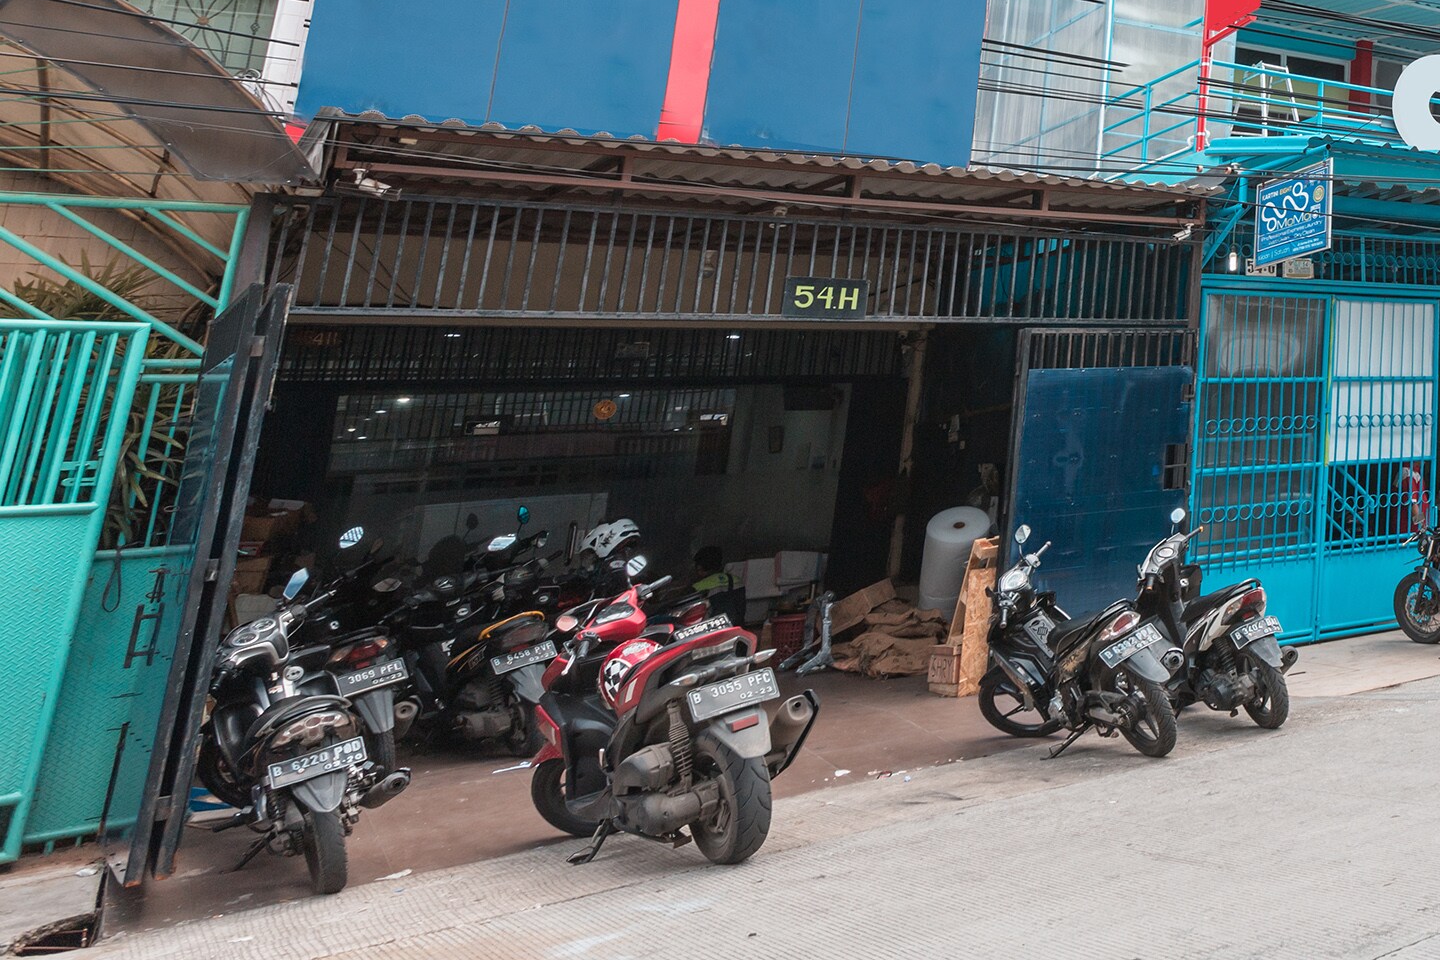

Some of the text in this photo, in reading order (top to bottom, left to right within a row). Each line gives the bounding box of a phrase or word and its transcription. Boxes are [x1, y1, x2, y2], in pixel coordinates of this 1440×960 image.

[794, 285, 859, 310] 54.H
[1234, 632, 1242, 640] B
[493, 658, 501, 666] B
[507, 649, 531, 661] 6458
[534, 642, 552, 654] PVF
[1104, 650, 1113, 659] B
[348, 662, 401, 684] 3069 PFL
[693, 672, 771, 704] B 3055 PFC
[740, 686, 773, 700] 02-23
[272, 766, 282, 777] B
[291, 751, 328, 771] 6220
